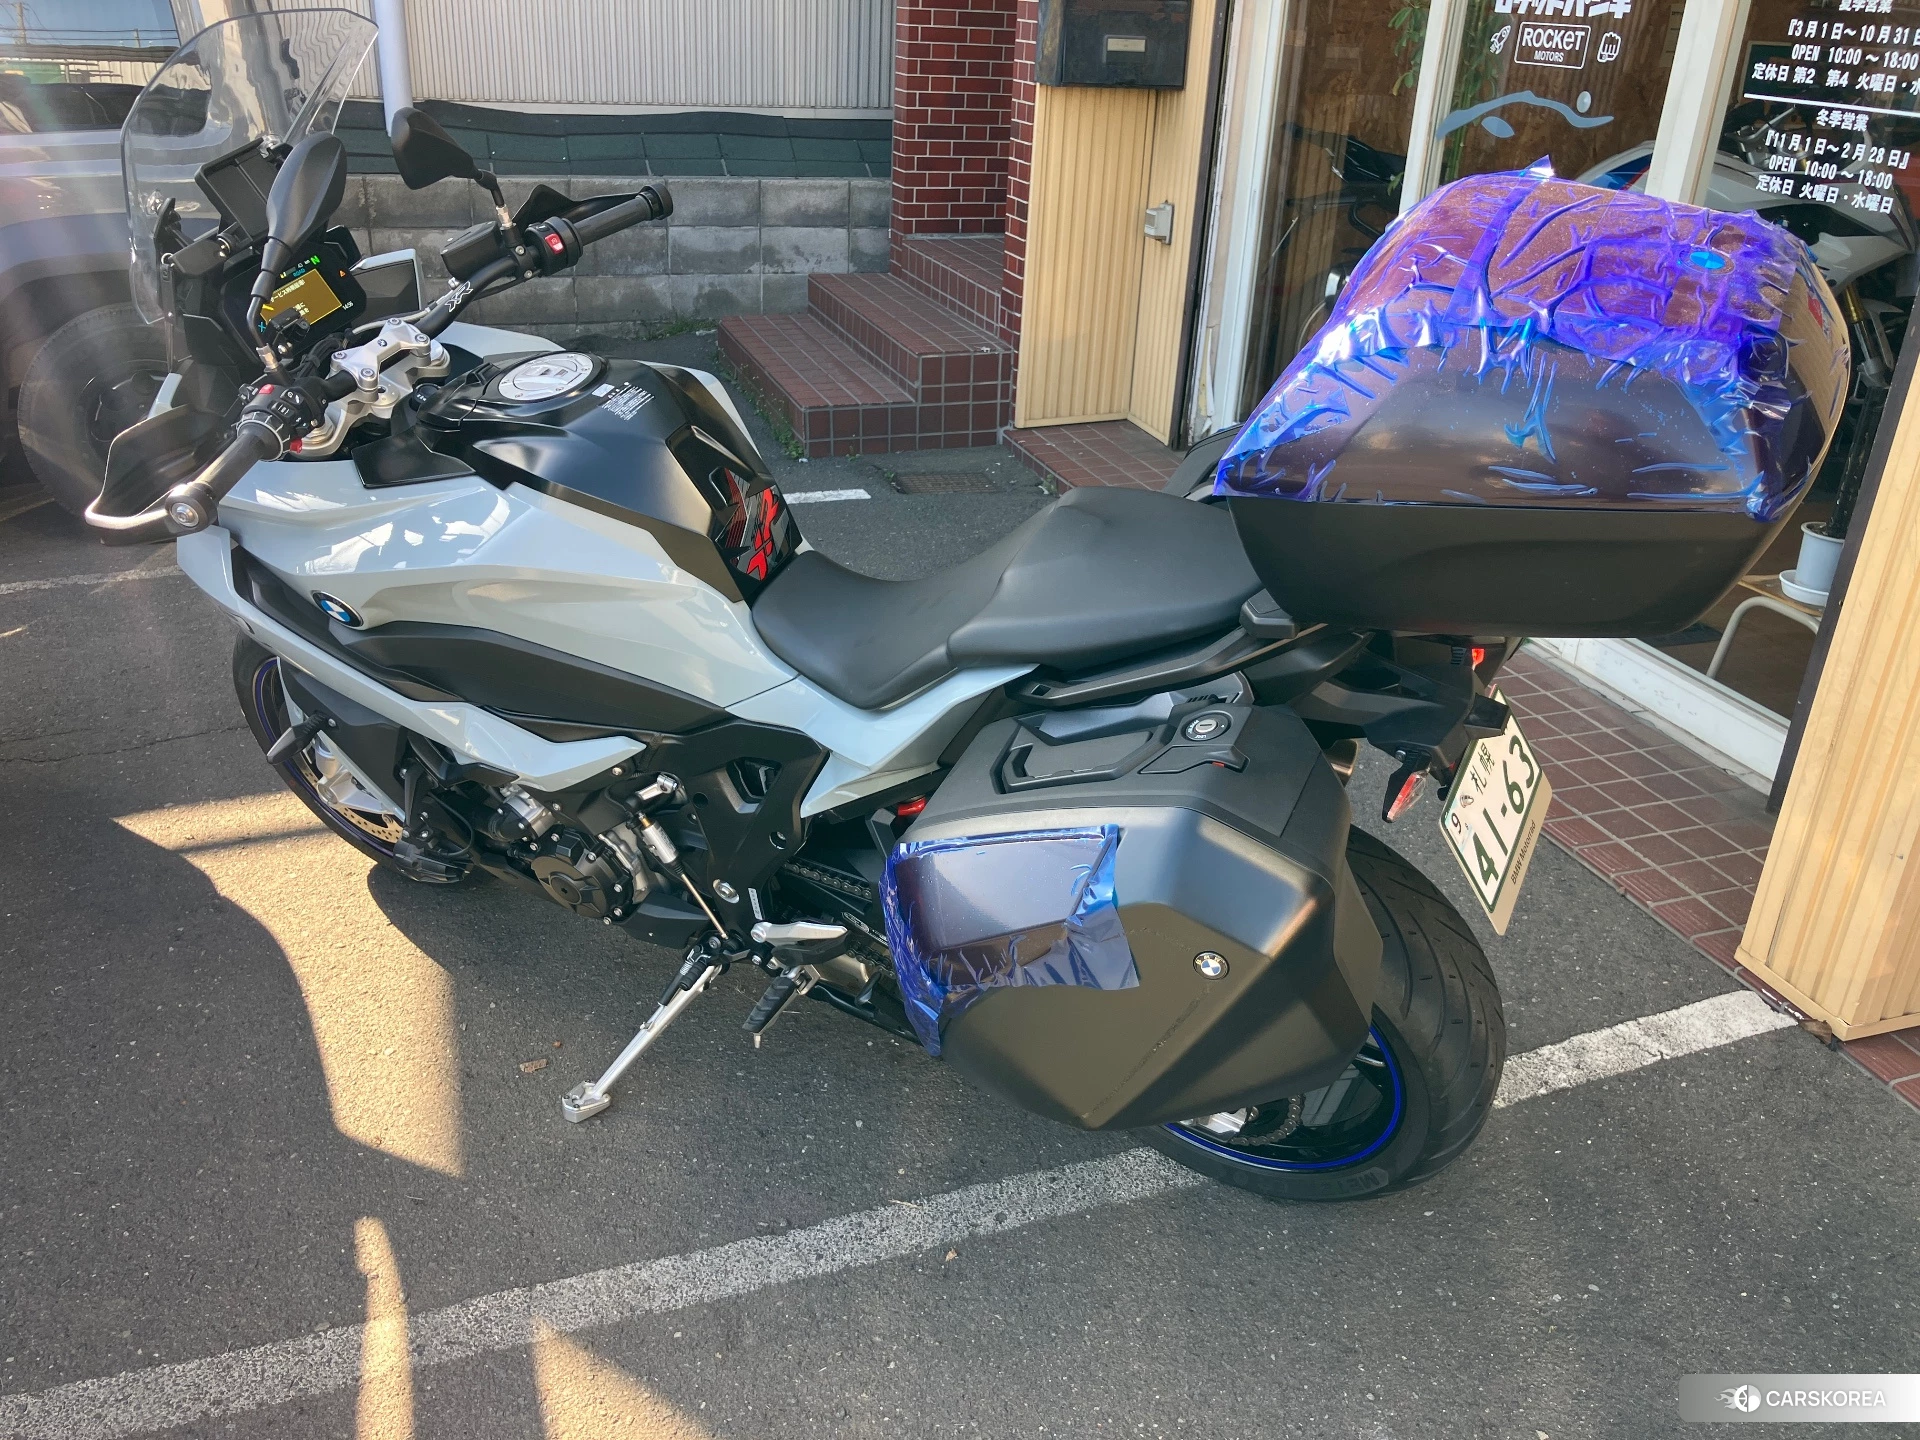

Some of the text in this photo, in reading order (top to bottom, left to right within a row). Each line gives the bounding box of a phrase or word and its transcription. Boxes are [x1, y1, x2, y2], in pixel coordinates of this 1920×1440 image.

[1534, 50, 1564, 63] MOTORS
[1791, 44, 1821, 62] OPEN
[1828, 46, 1862, 65] 10:00
[1883, 51, 1919, 70] 18:00
[1751, 62, 1790, 82] 定休日
[1816, 109, 1869, 132] 冬季営業
[1768, 154, 1797, 173] OPEN
[1804, 160, 1837, 180] 10:00
[1857, 169, 1893, 190] 18:00
[1756, 175, 1794, 196] 定休日
[1470, 742, 1495, 796] 札幌
[1473, 734, 1534, 887] 41-63
[1511, 857, 1523, 885] BMW
